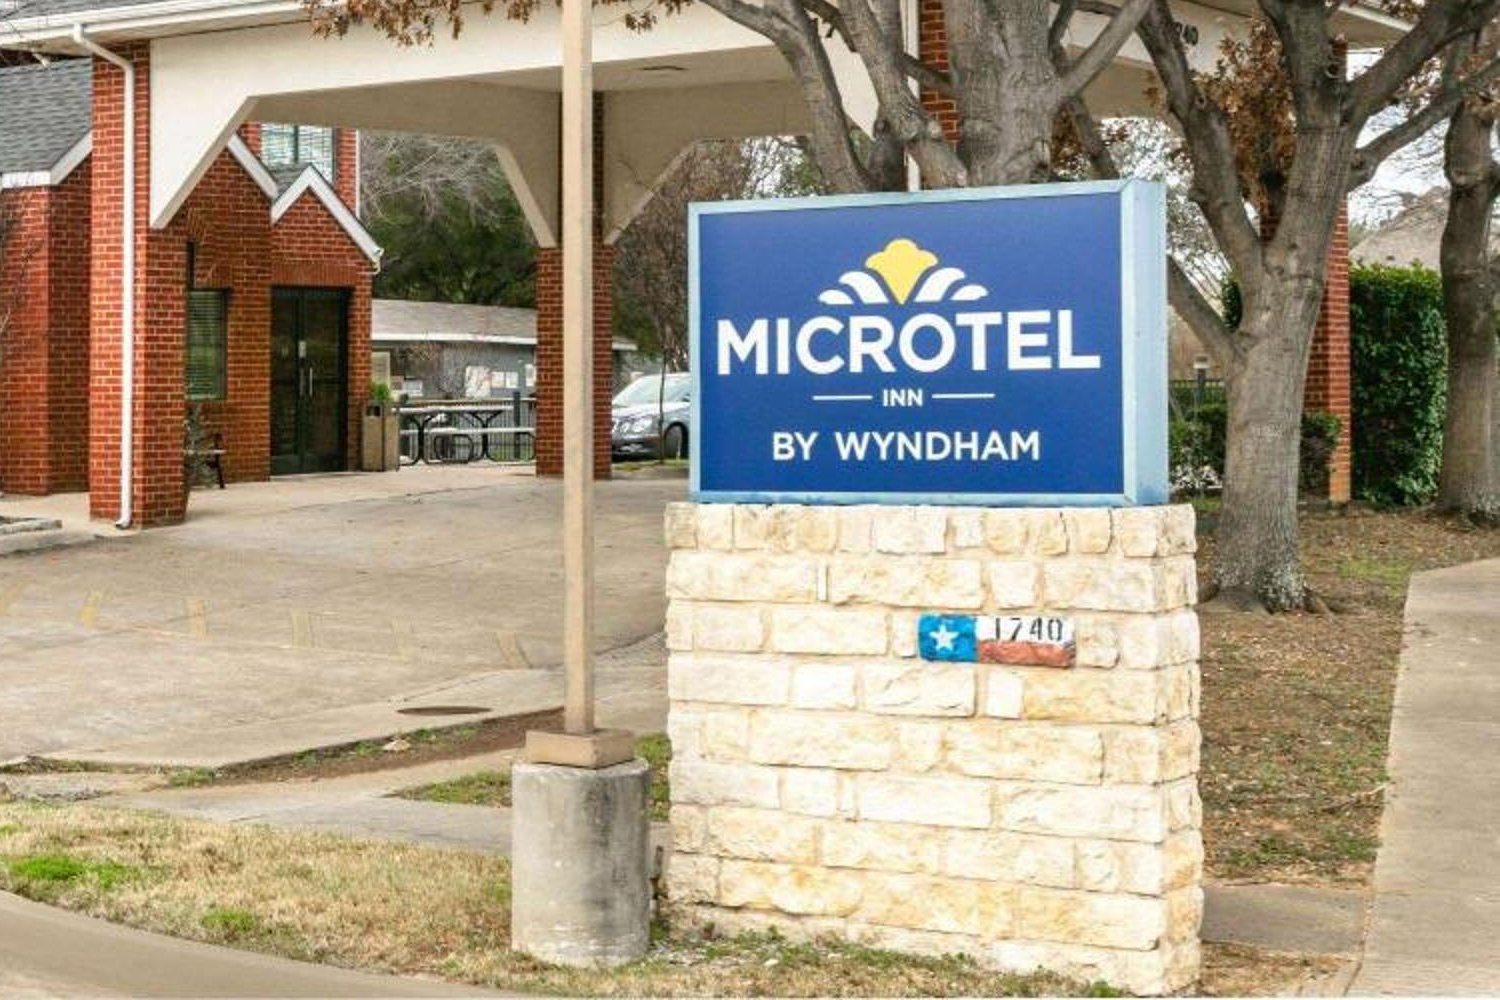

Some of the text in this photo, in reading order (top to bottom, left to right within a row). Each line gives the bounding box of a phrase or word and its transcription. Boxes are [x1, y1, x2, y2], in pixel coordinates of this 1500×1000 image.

[717, 309, 1101, 376] MICROTEL
[882, 388, 923, 408] INN
[772, 430, 1040, 461] BY WYNDHAM
[994, 617, 1064, 642] 1740
